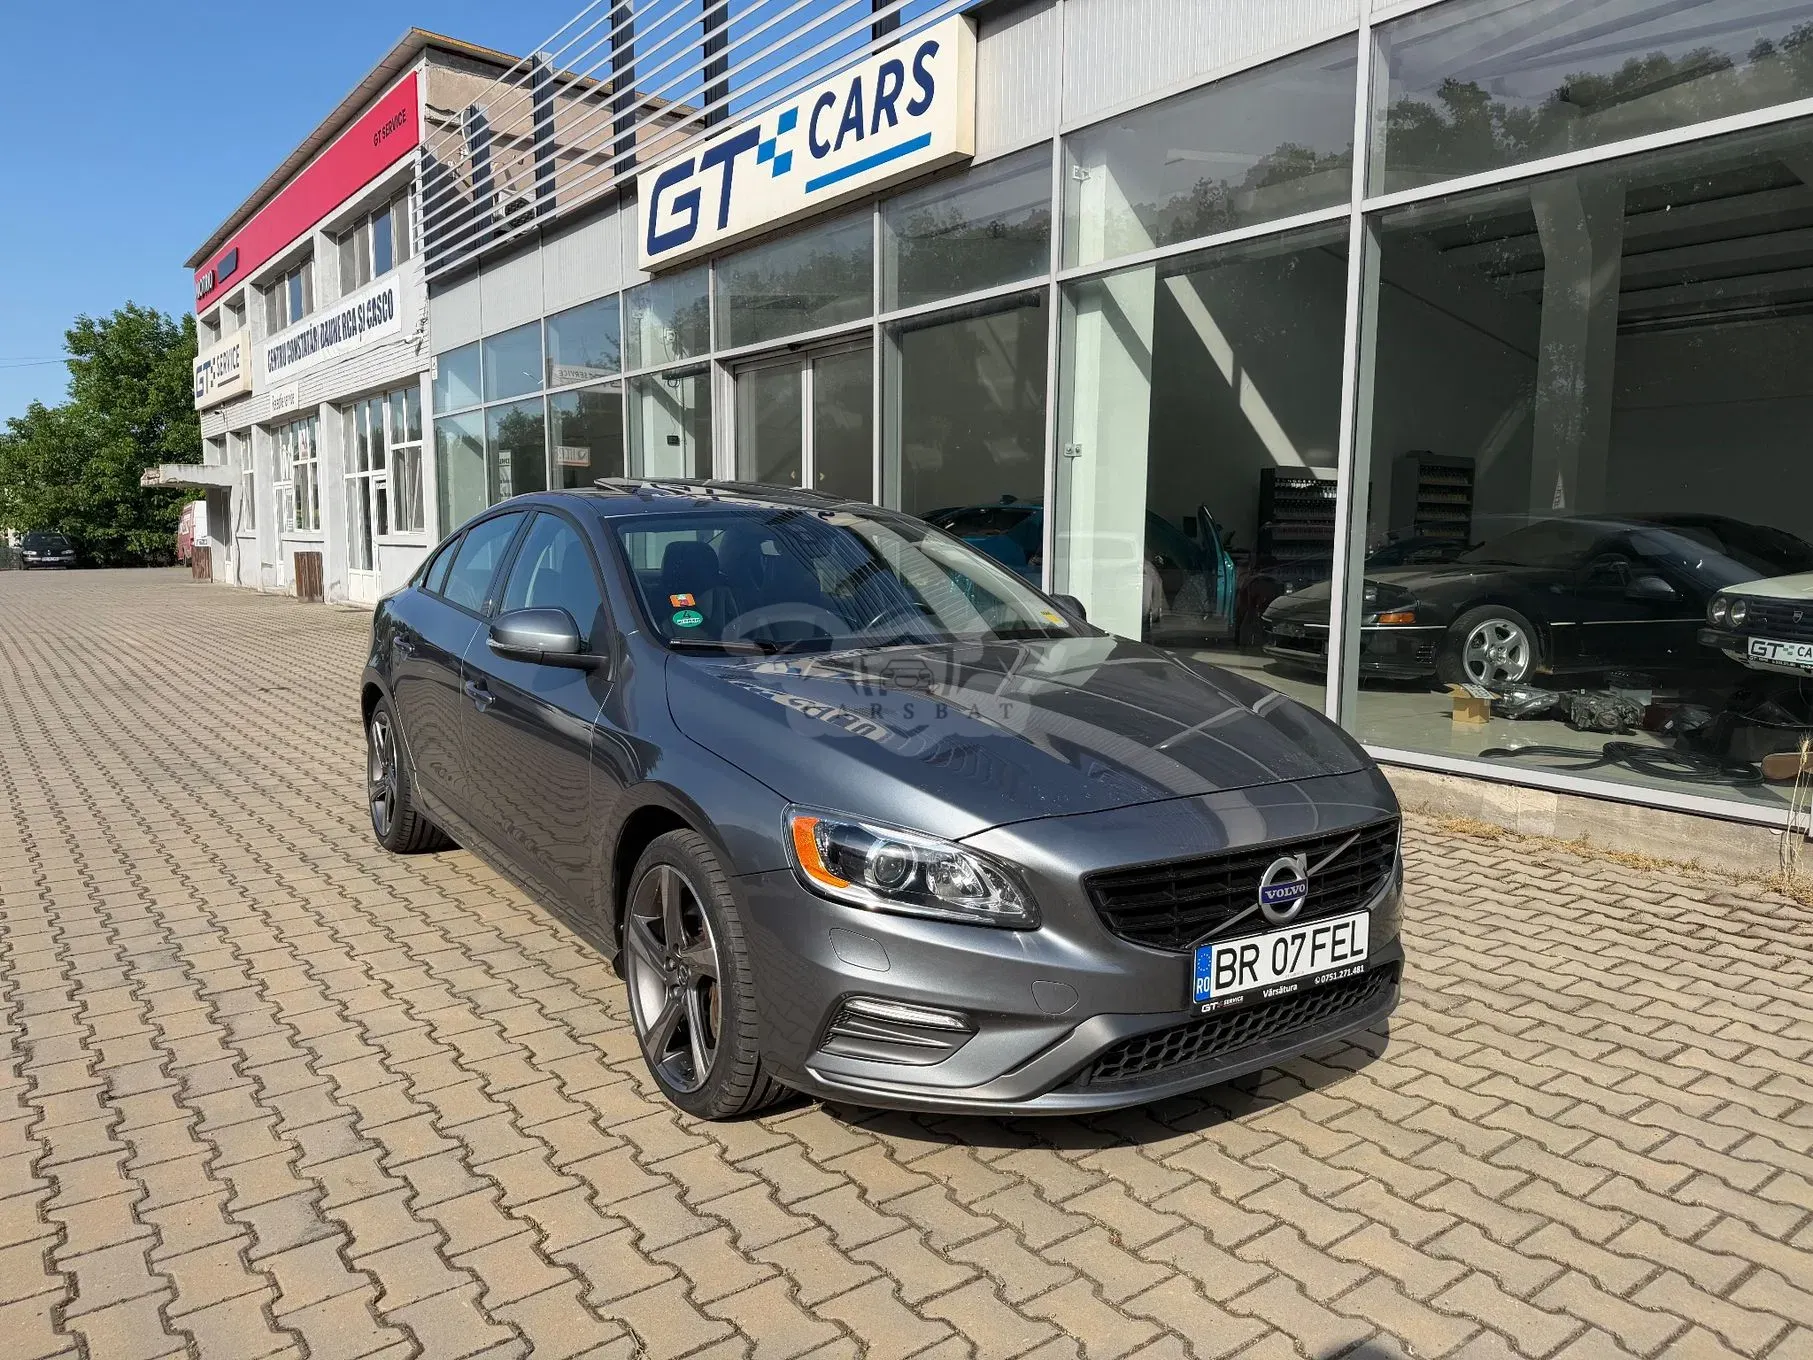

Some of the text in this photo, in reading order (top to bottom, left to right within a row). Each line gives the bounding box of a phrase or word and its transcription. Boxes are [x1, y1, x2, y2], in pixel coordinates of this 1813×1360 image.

[373, 108, 407, 147] GT SERVICE
[647, 40, 940, 256] GT CARS
[320, 314, 342, 348] DAUNE
[341, 307, 358, 341] RCA
[366, 288, 394, 330] CASCO
[196, 343, 240, 398] GT SERVICE
[1751, 640, 1784, 658] GT
[1264, 883, 1306, 899] VOLVO
[1214, 944, 1260, 991] BR
[1320, 964, 1365, 984] 0751.271.481
[1195, 976, 1211, 995] RO
[1201, 1001, 1219, 1013] GT
